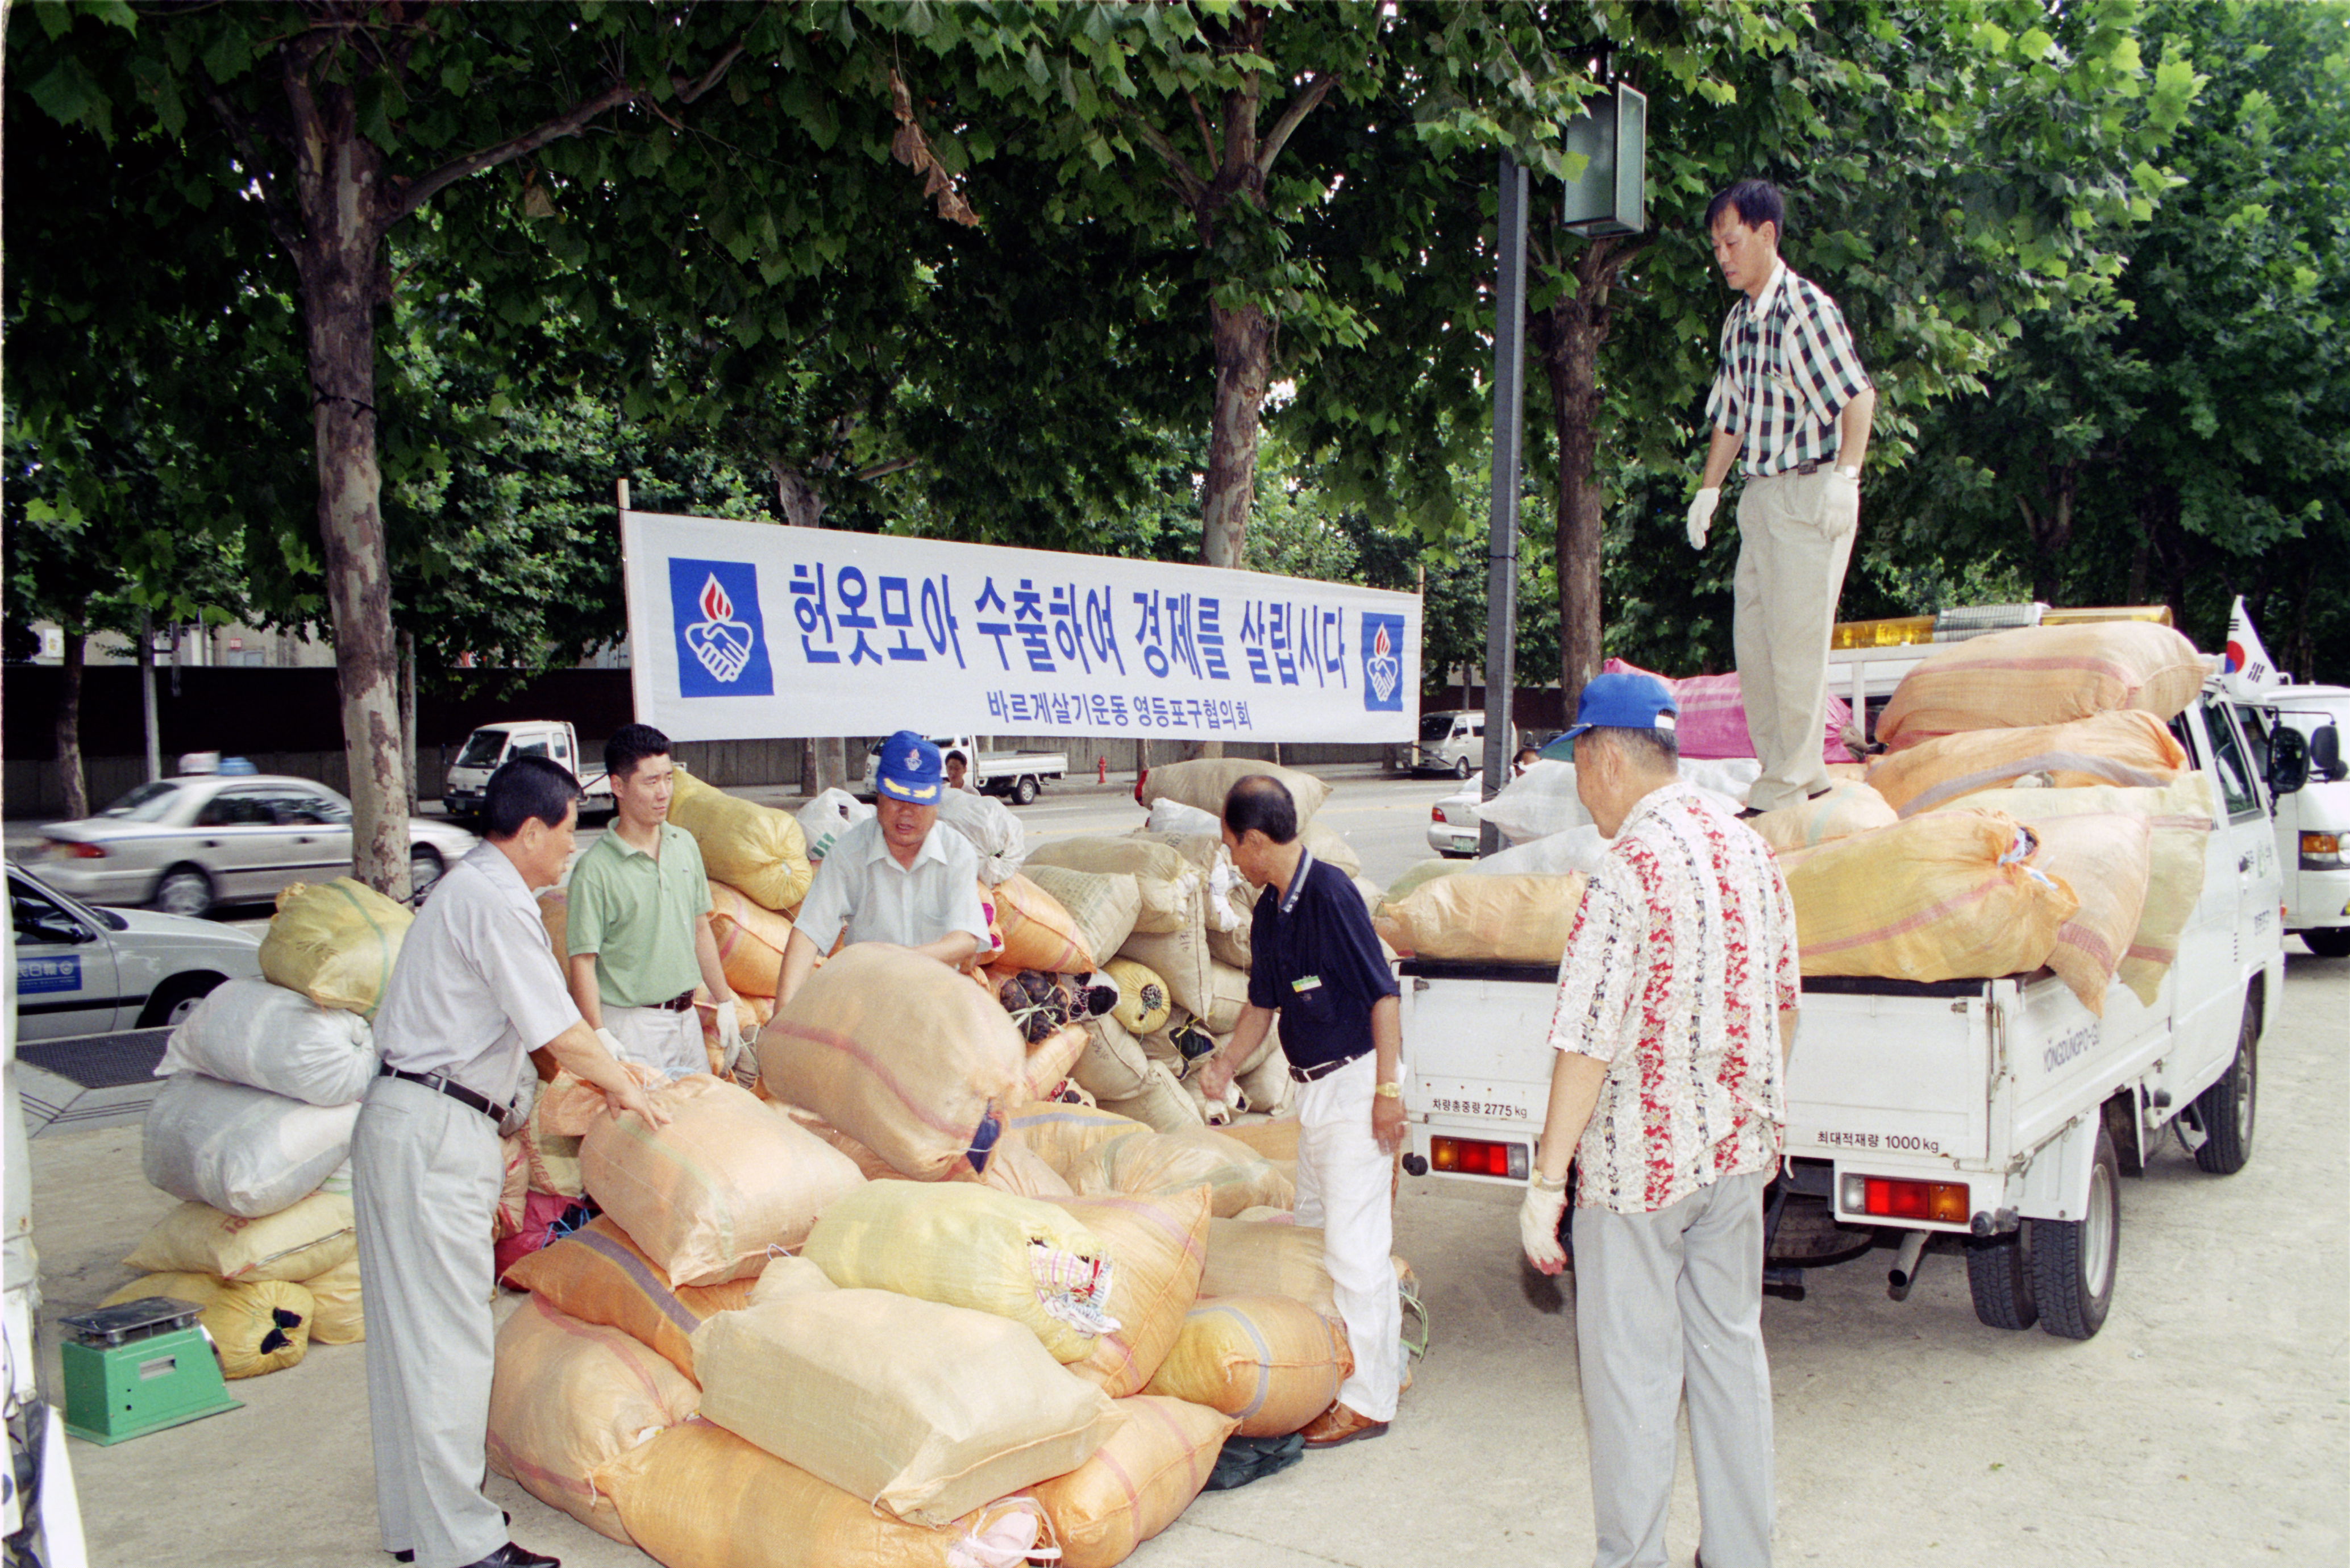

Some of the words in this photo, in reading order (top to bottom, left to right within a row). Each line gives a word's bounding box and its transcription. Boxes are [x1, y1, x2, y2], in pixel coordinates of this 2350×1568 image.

[789, 562, 966, 669] 헌옷모아
[975, 576, 1125, 675] 수출하여
[1133, 589, 1230, 680] 경제를
[1240, 600, 1347, 688] 살립시다
[987, 690, 1129, 727] 바르게살기운동
[1133, 696, 1253, 730] 영등포구협의회
[1432, 1098, 1480, 1114] 차량총중량
[1484, 1103, 1512, 1117] 2775
[1514, 1105, 1528, 1119] kg
[1817, 1131, 1879, 1148] 최대적재량
[1885, 1136, 1920, 1150] 1000
[1923, 1138, 1939, 1154] kg
